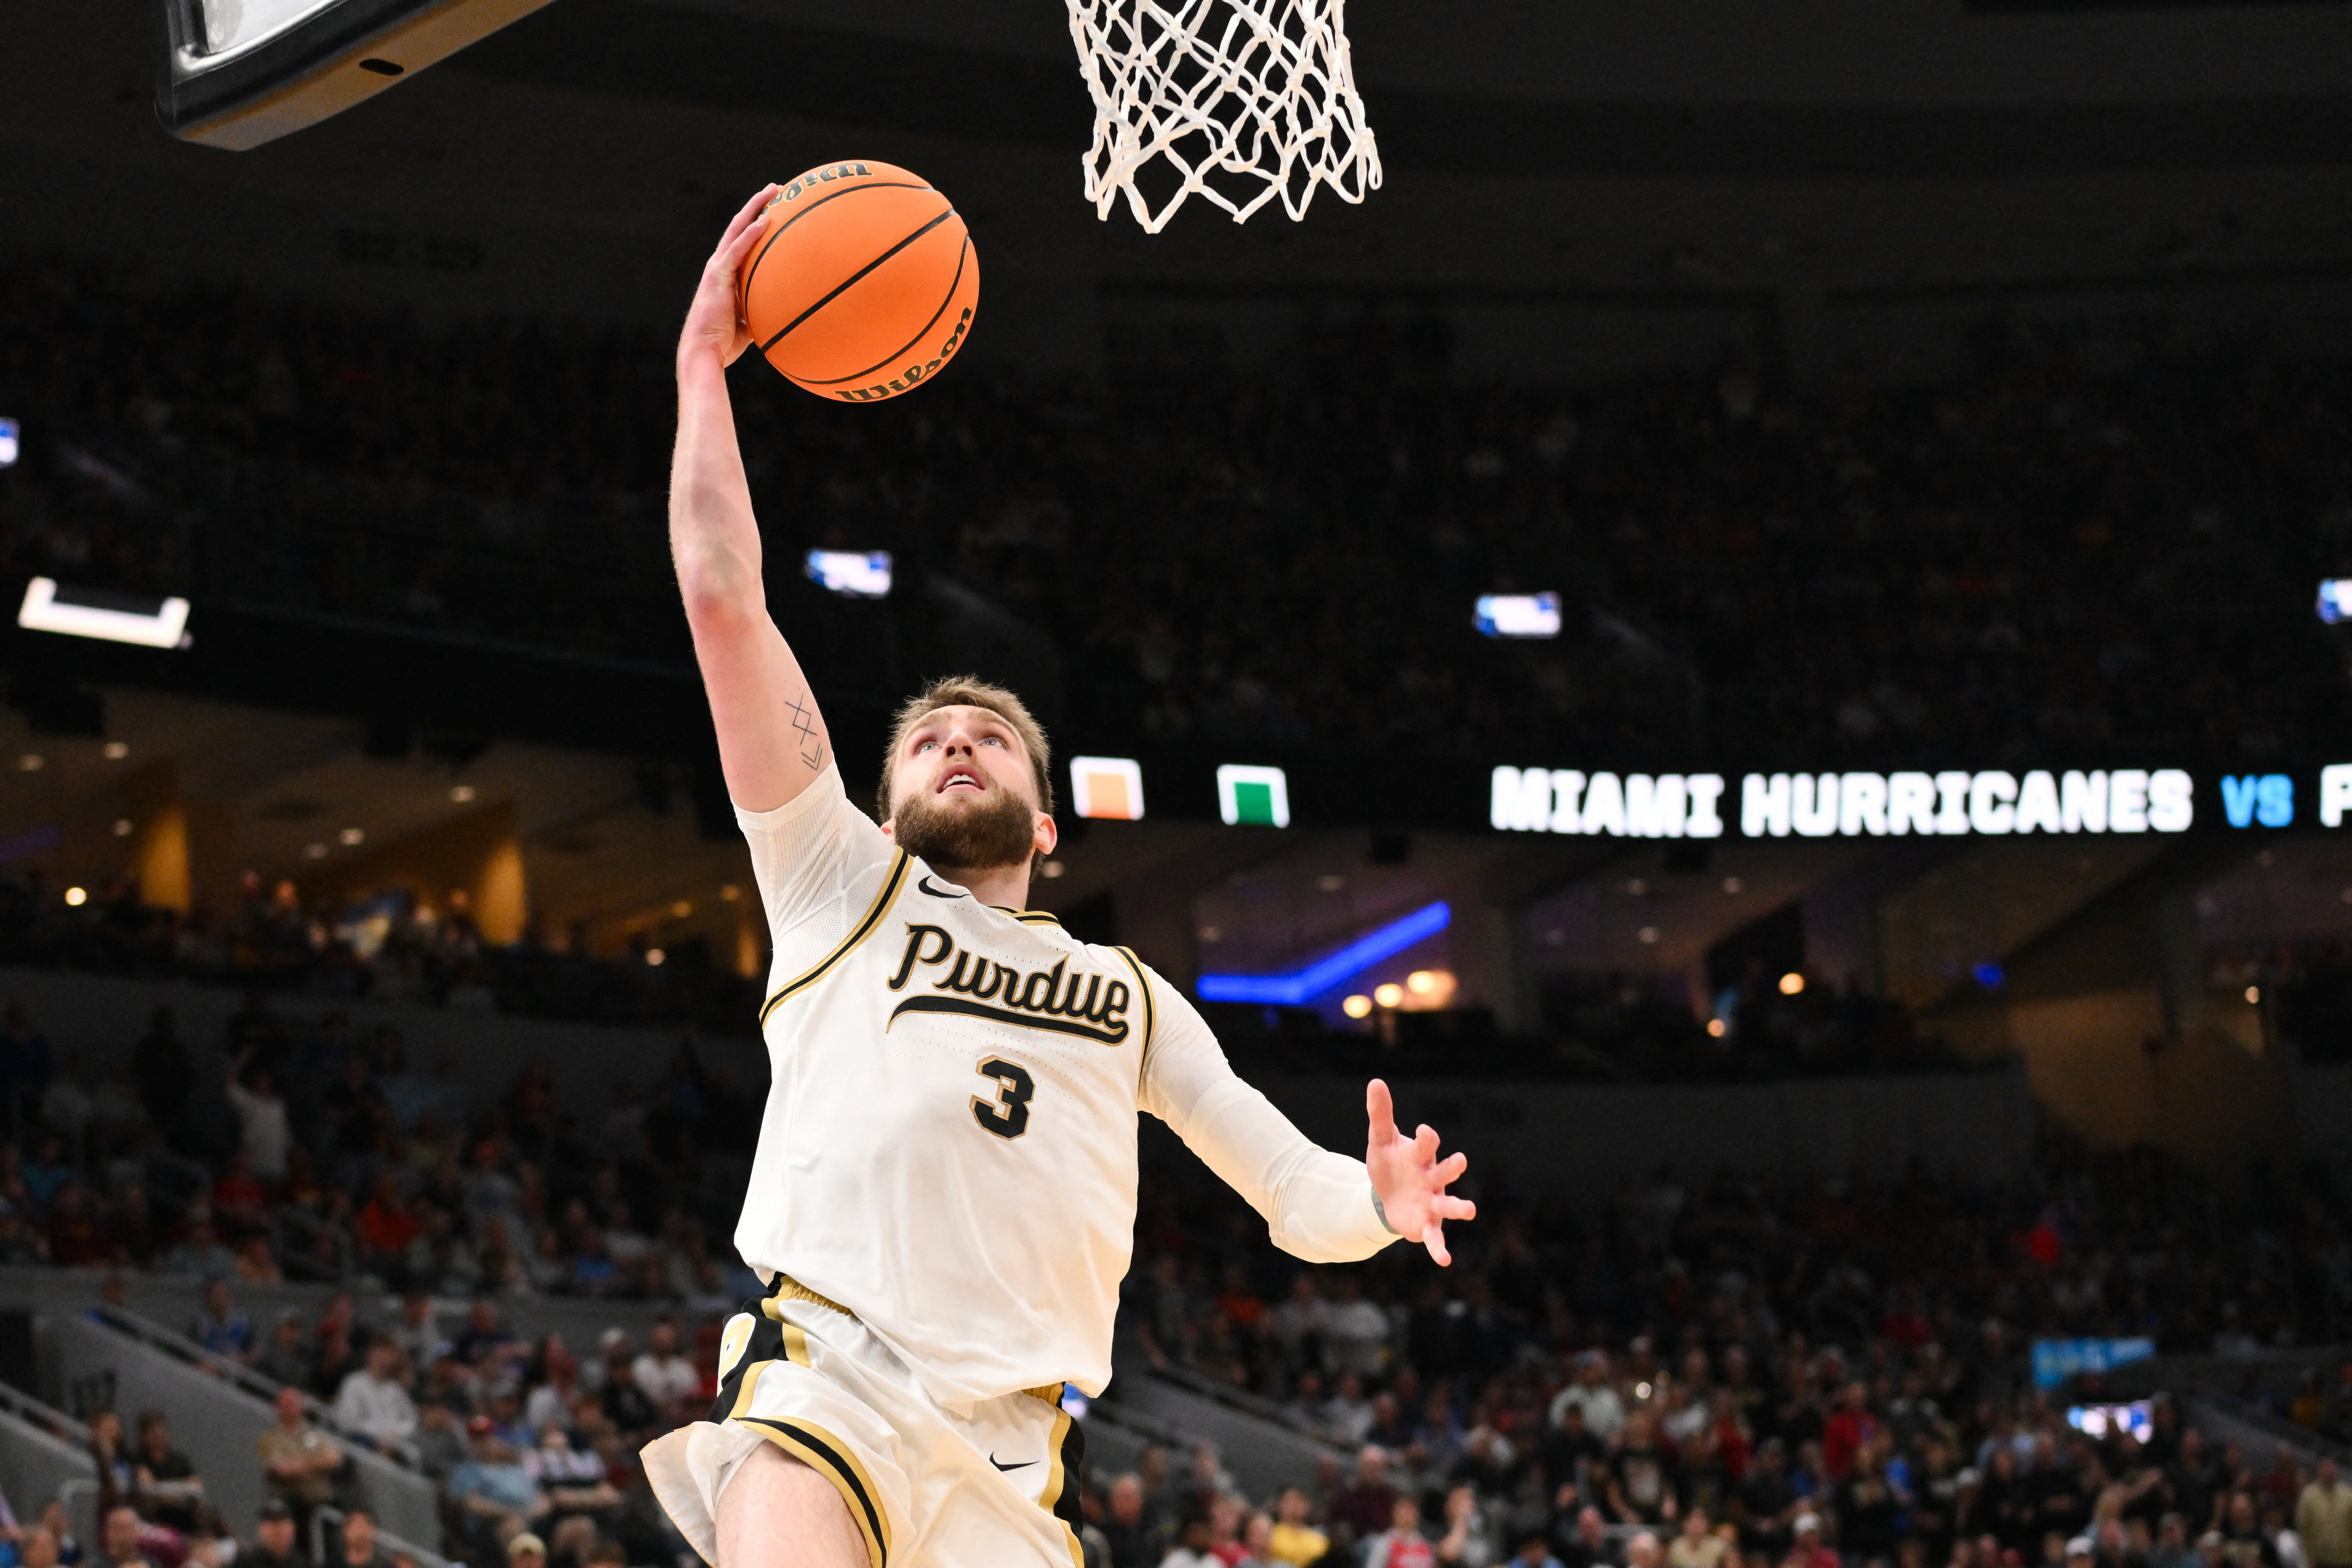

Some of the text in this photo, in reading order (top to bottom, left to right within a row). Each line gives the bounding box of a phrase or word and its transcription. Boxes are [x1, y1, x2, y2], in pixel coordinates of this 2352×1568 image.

[761, 163, 874, 216] Wils
[834, 307, 972, 400] Wilson
[1490, 765, 1725, 838] MIAMI
[1741, 769, 2193, 837] HURRICANES
[2220, 773, 2295, 828] VS
[887, 922, 1130, 1030] Purdue
[969, 1054, 1036, 1140] 3
